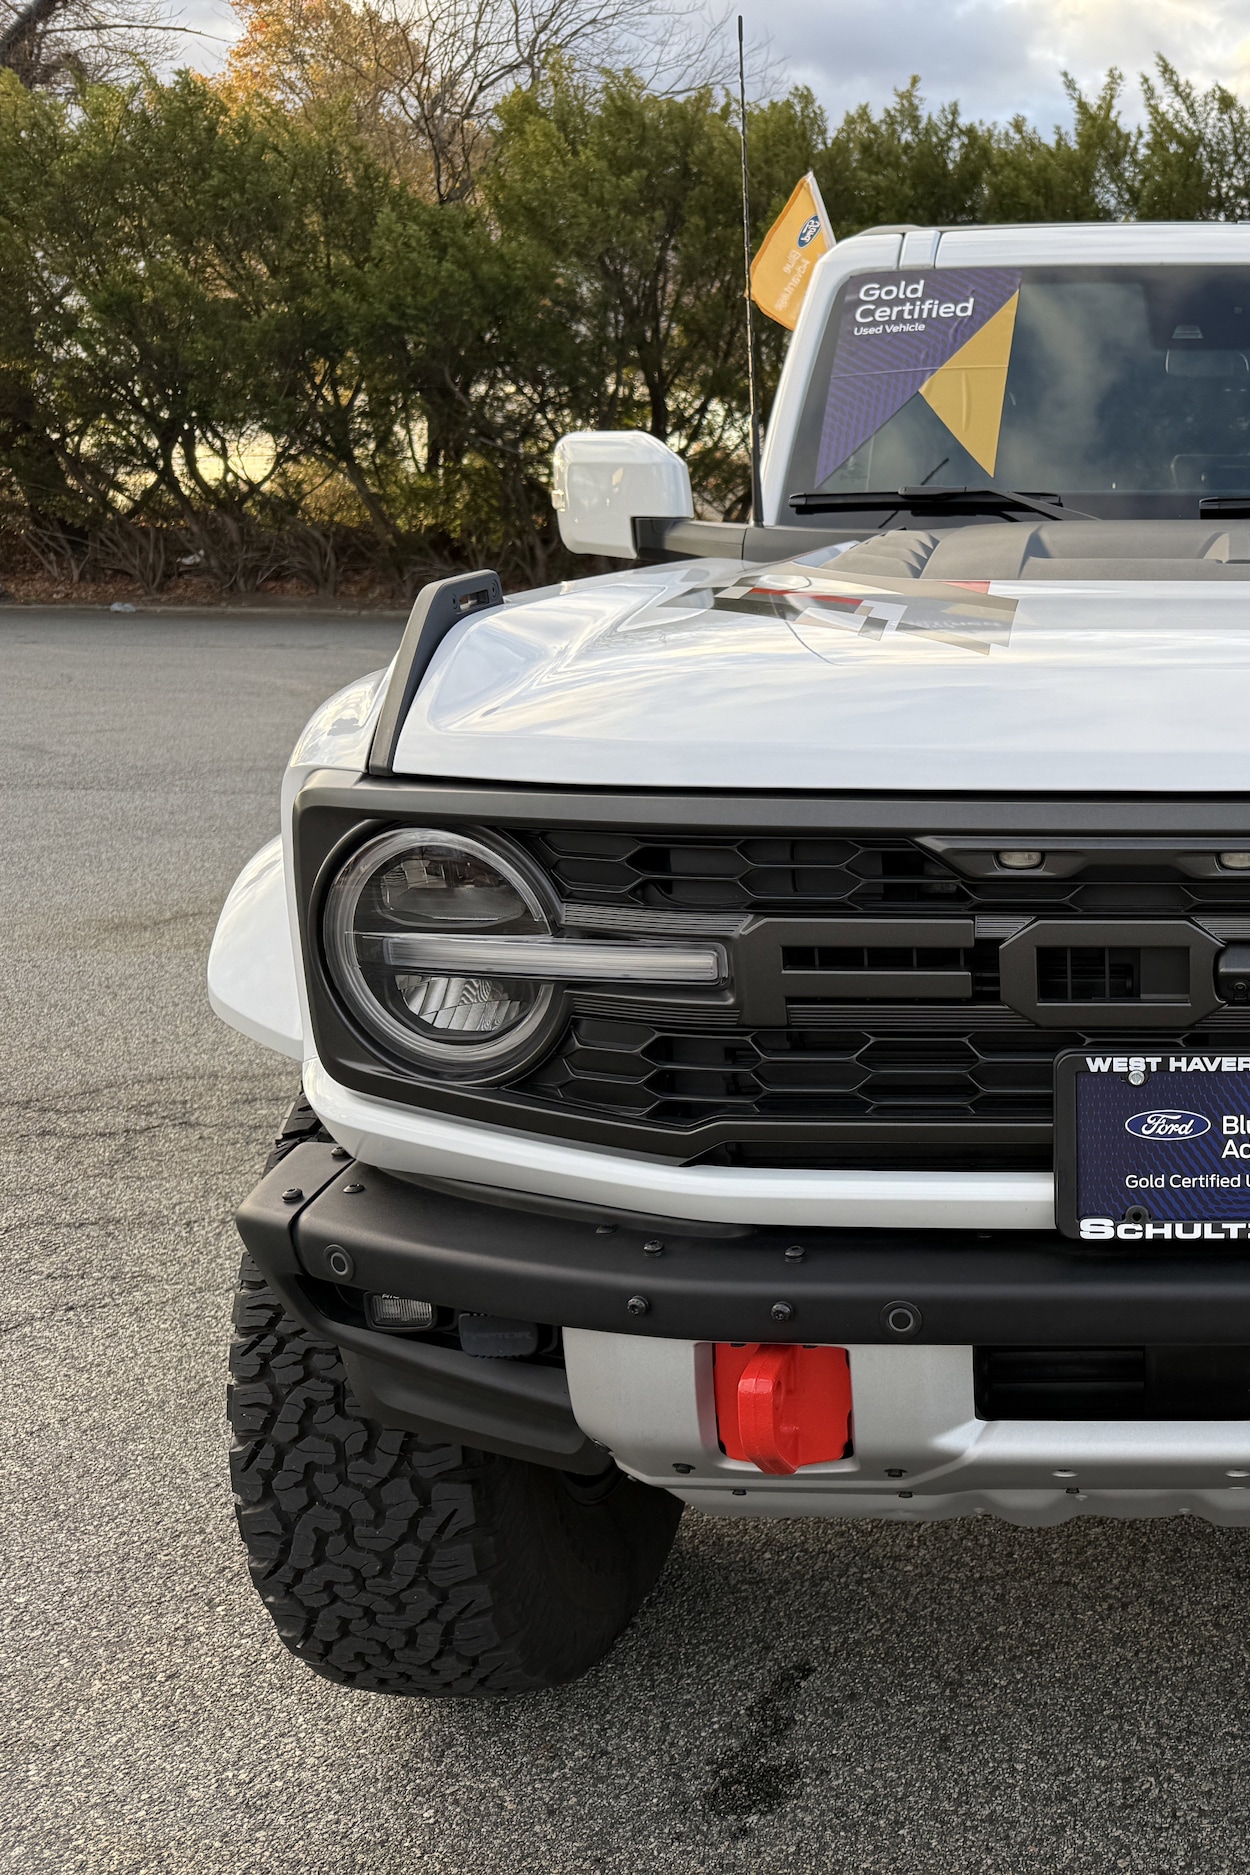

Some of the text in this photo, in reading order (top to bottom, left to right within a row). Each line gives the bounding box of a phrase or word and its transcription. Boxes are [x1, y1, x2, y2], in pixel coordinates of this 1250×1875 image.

[858, 279, 925, 302] Gold
[854, 297, 975, 323] Certified
[853, 322, 926, 336] Used Vehicle
[1085, 1057, 1162, 1073] WEST
[1124, 1173, 1166, 1189] Gold
[1168, 1173, 1240, 1189] Certified
